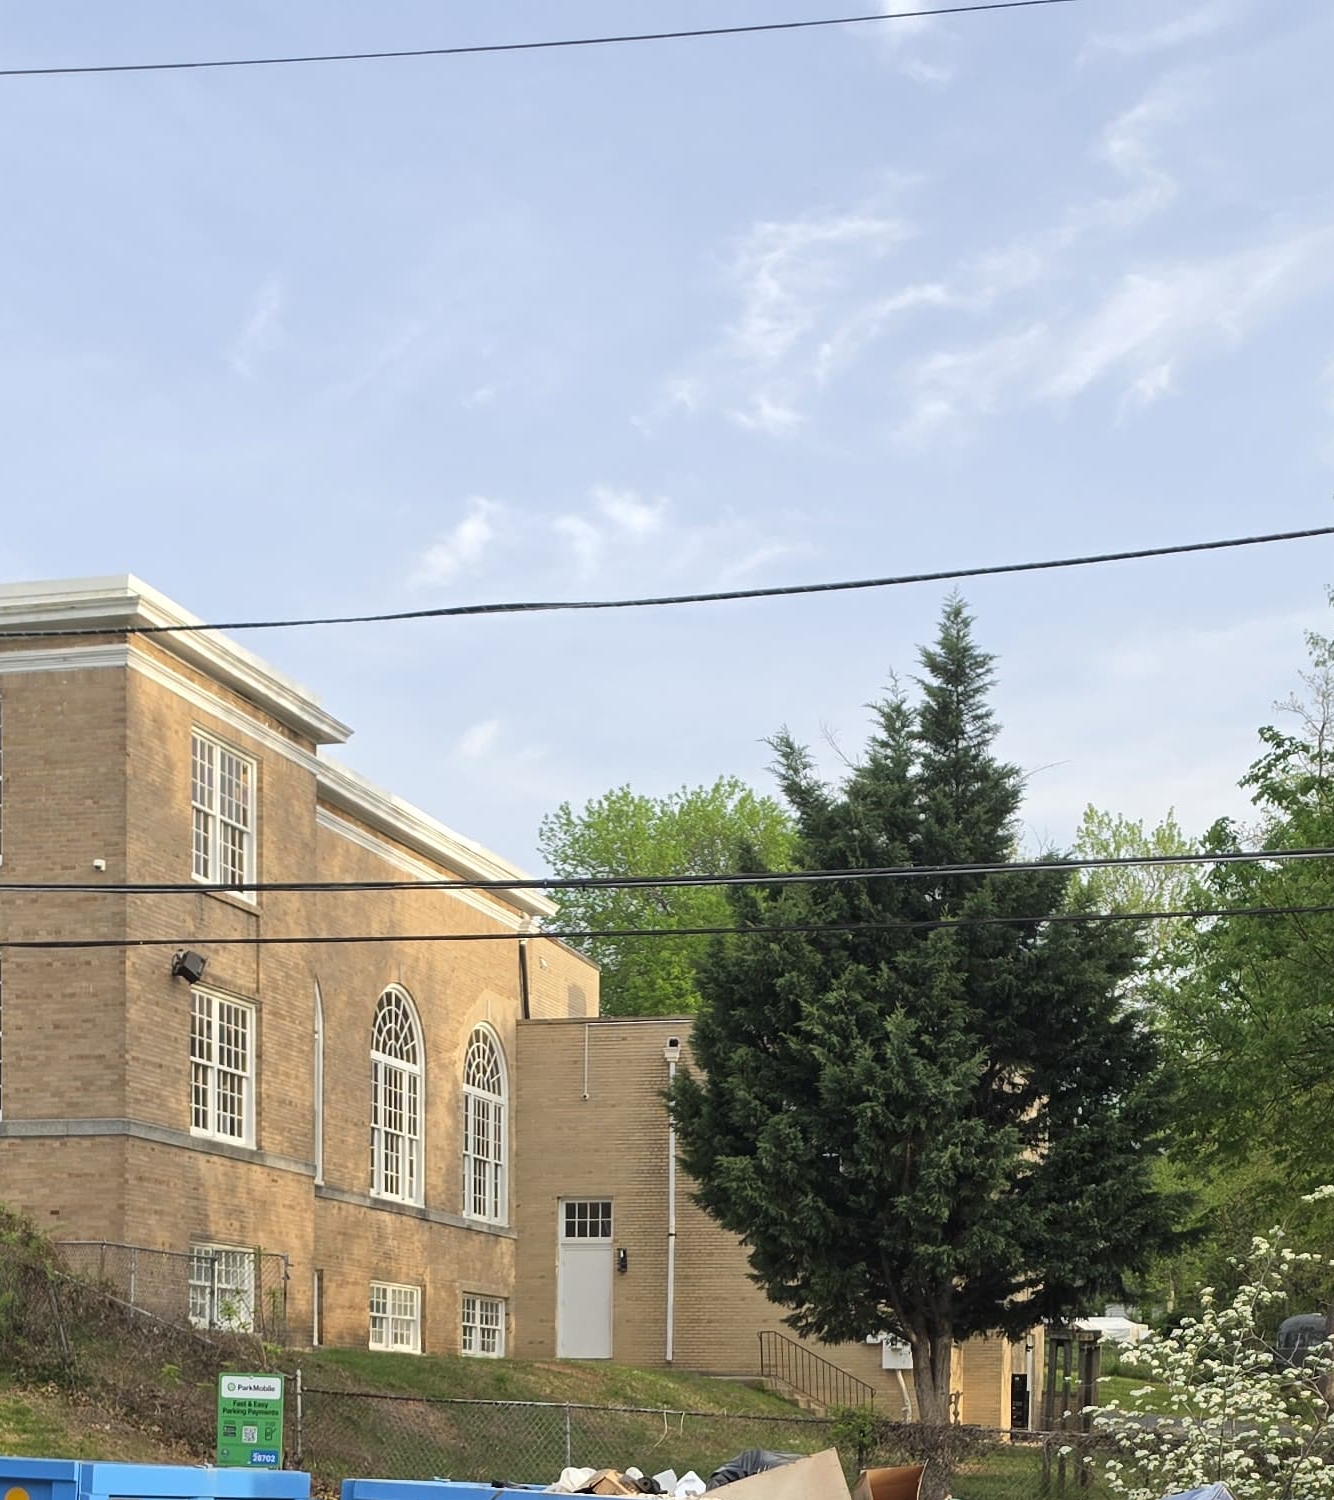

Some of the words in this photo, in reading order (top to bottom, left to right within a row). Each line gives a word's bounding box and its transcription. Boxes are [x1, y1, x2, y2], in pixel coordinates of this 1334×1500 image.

[237, 1384, 276, 1392] ParkMobile
[223, 1408, 247, 1416] Parking
[248, 1408, 279, 1417] Payments
